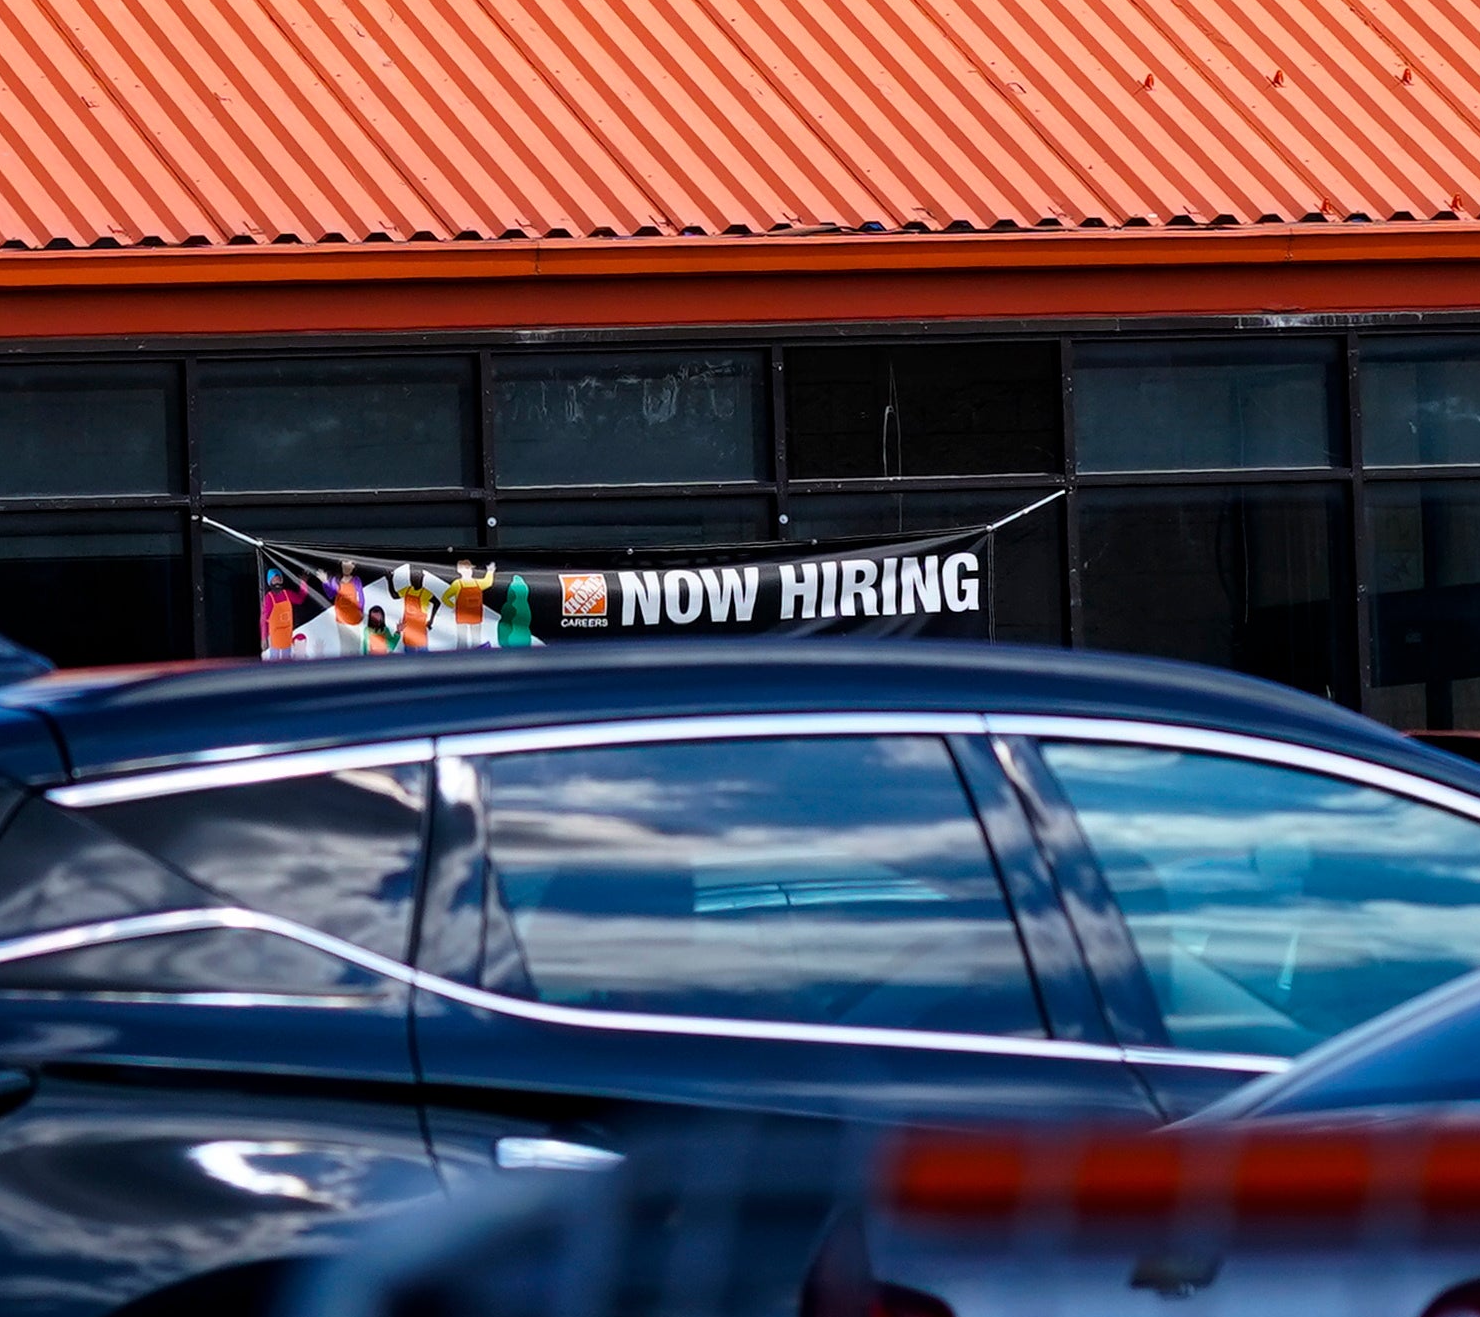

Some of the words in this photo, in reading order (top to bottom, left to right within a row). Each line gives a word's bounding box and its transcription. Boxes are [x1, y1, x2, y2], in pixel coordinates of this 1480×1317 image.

[564, 575, 604, 614] HOME
[616, 566, 759, 627] NOW
[778, 551, 981, 621] HIRING
[560, 618, 609, 628] CAREERS
